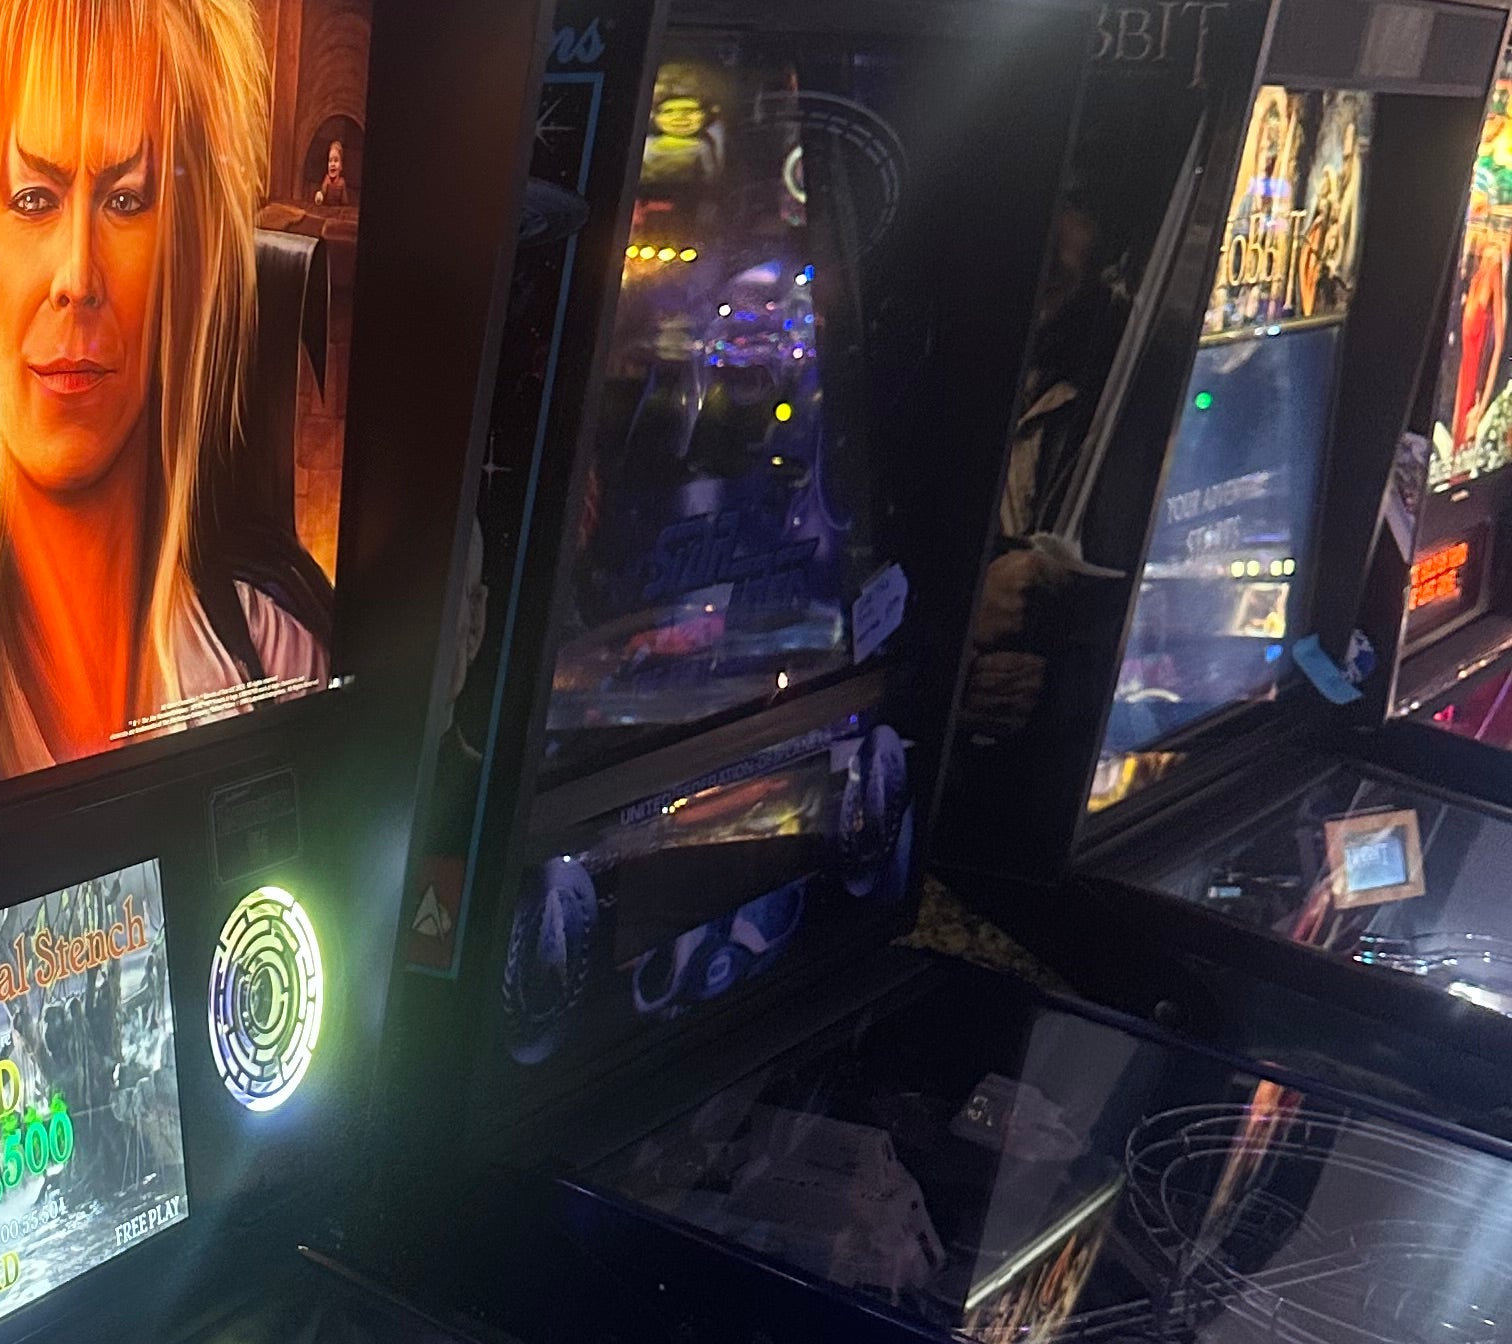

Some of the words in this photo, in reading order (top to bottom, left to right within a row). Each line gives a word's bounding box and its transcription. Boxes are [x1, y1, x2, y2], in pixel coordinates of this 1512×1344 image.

[34, 894, 149, 989] Stench
[114, 1215, 149, 1247] FREE
[148, 1195, 181, 1229] PLAY
